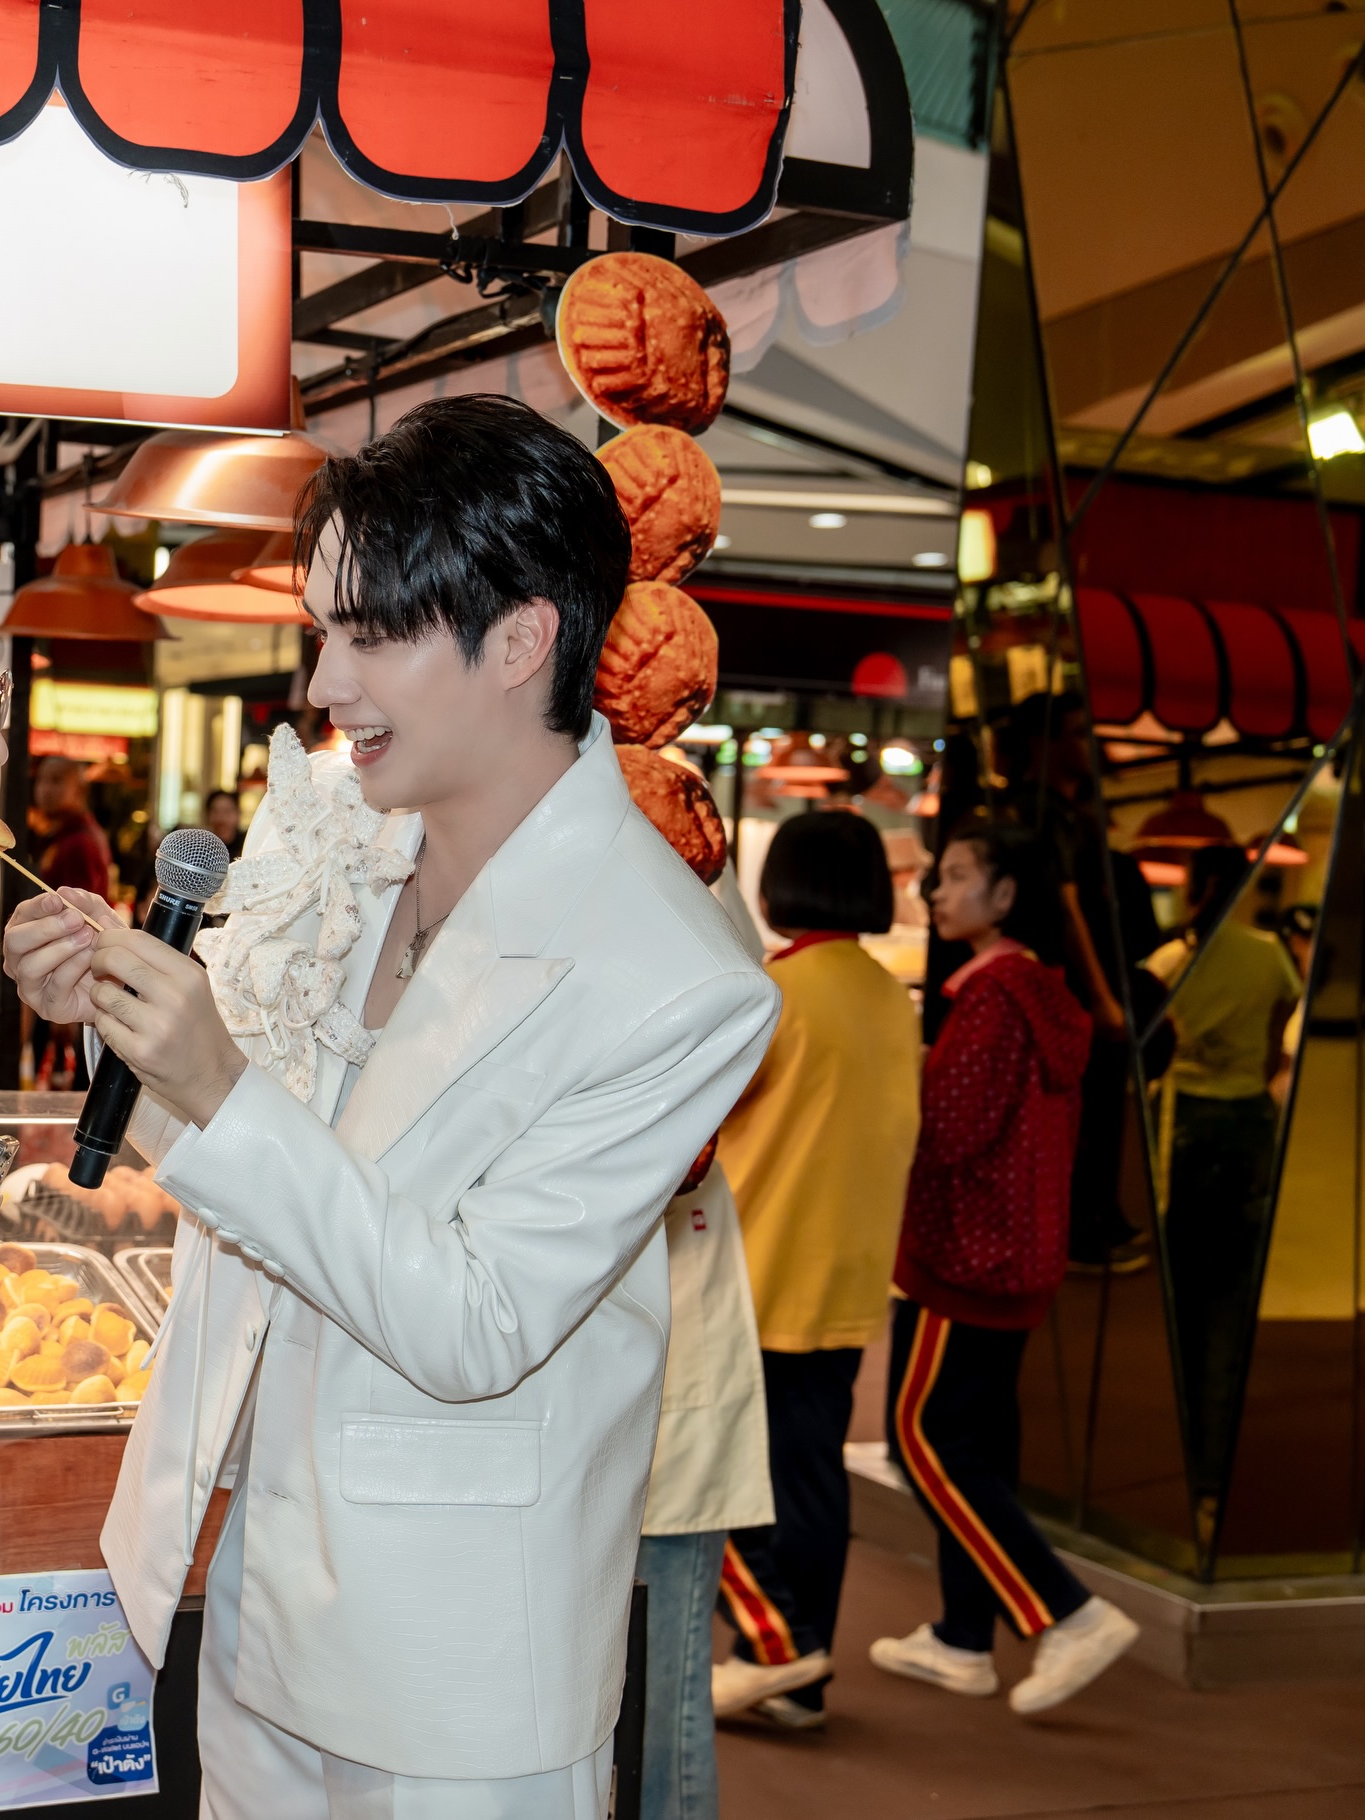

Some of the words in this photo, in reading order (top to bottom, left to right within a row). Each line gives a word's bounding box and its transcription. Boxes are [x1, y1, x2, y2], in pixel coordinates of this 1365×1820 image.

[158, 892, 181, 907] SHURE
[19, 1589, 116, 1613] โครงการ
[66, 1622, 129, 1659] พลัส
